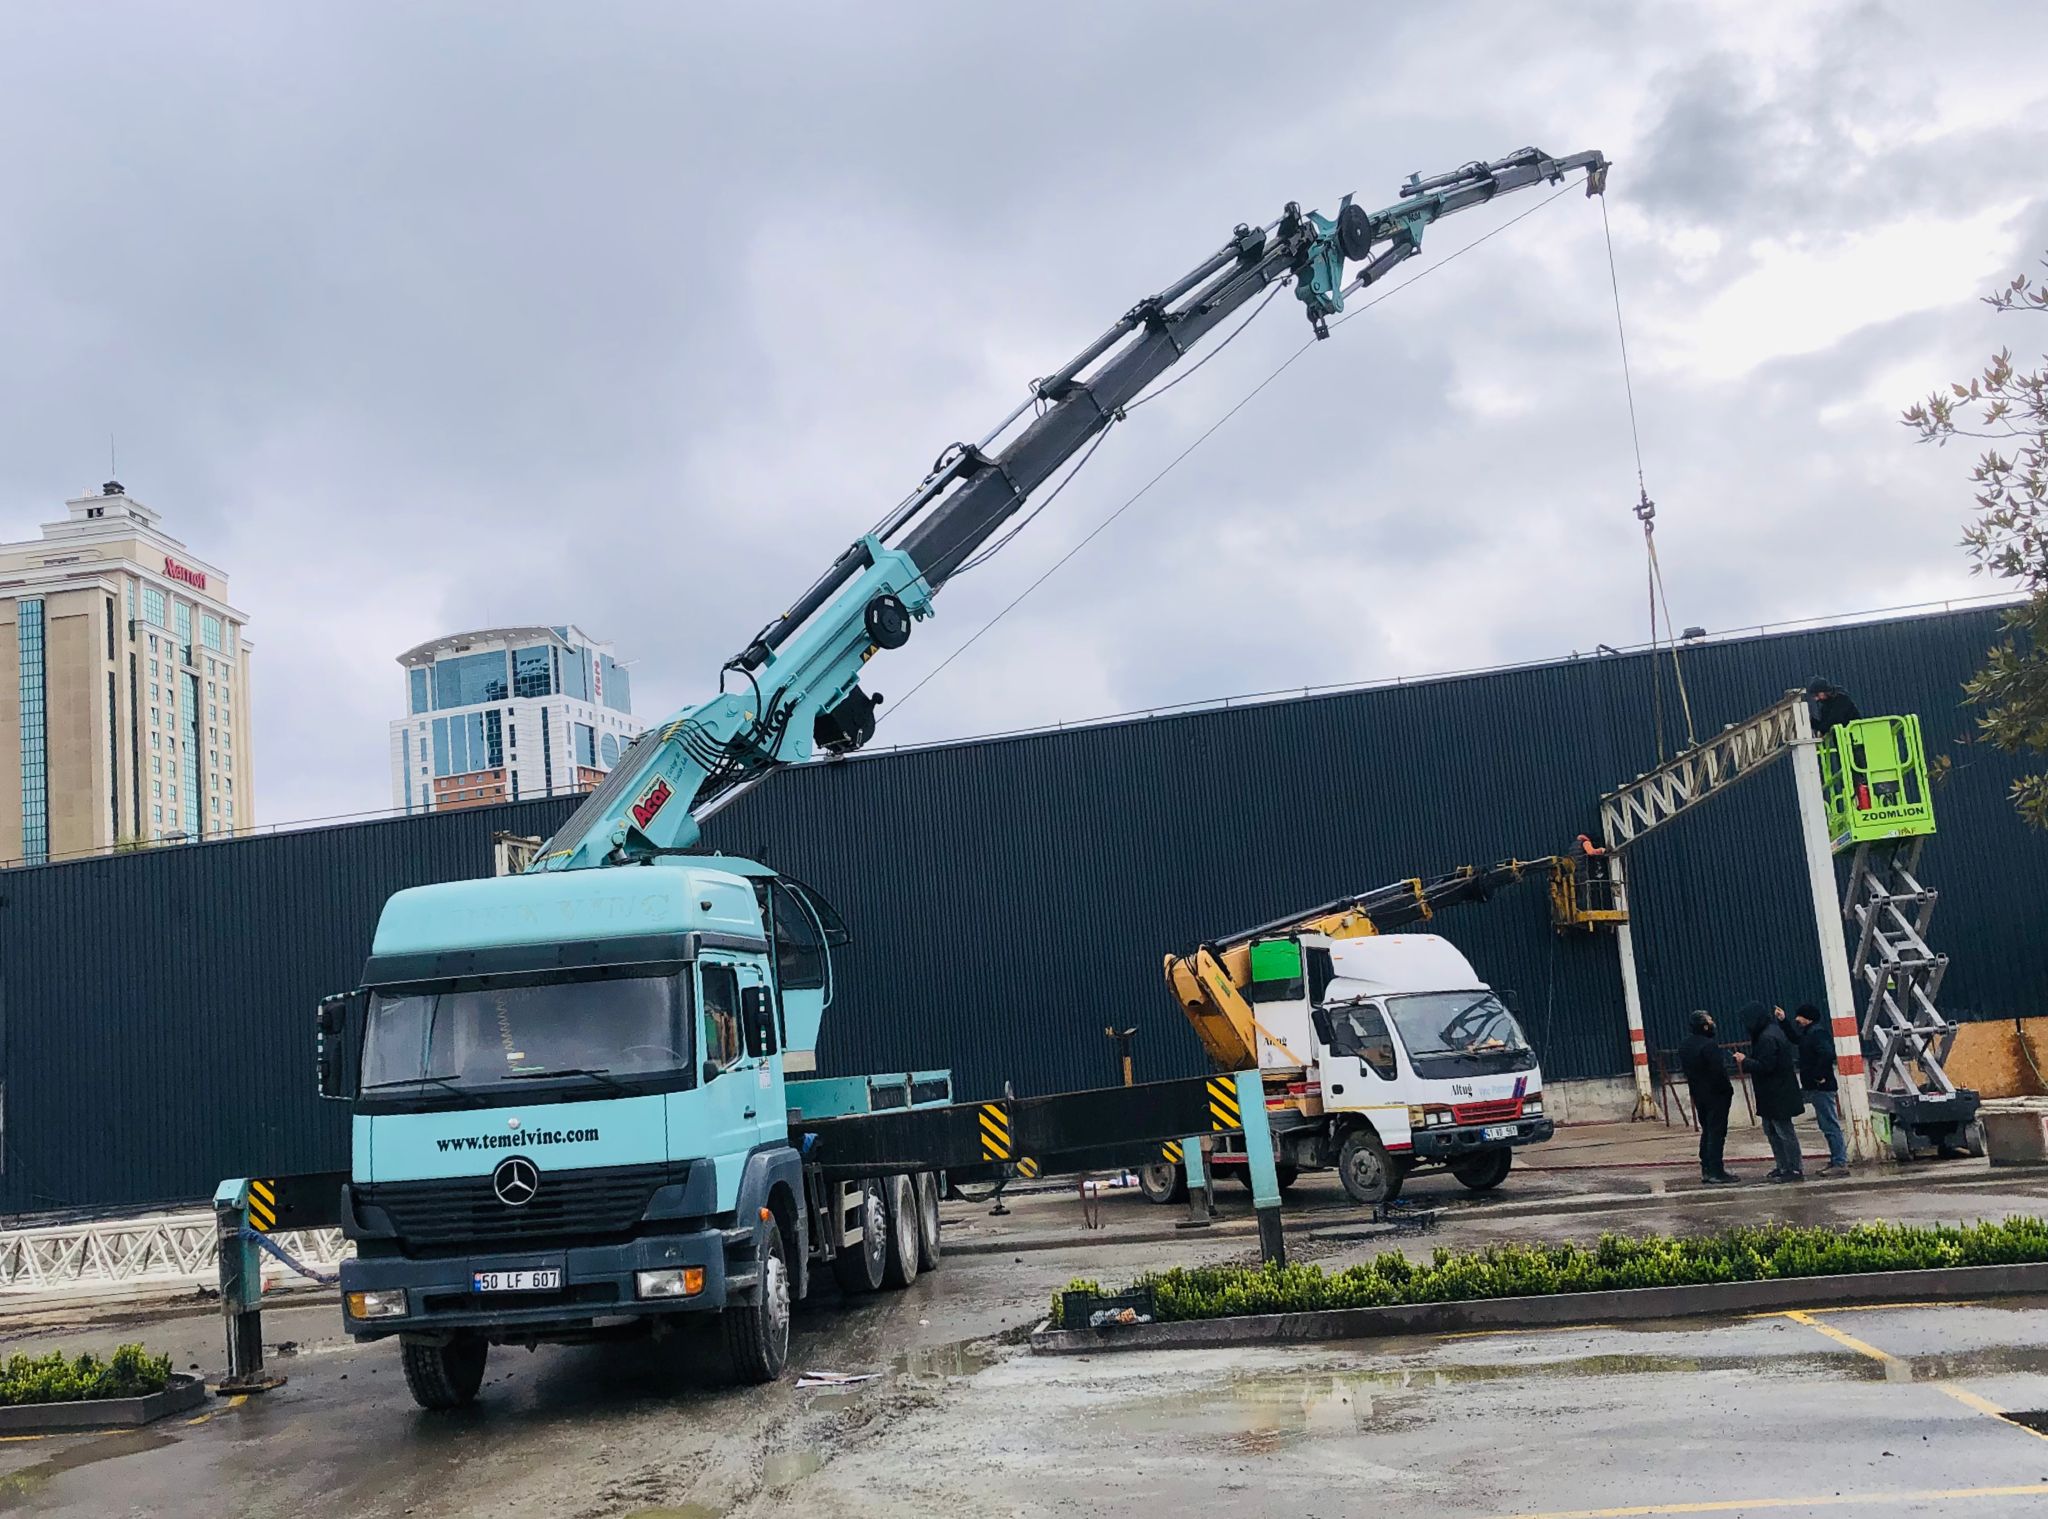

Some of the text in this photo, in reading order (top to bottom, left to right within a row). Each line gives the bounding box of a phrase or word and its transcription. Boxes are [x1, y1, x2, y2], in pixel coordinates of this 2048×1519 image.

[632, 780, 672, 830] Acar
[1862, 806, 1925, 821] ZOOMLION
[437, 1128, 599, 1152] www.temelvinc.com
[482, 1274, 498, 1289] 50
[507, 1273, 523, 1288] LF
[532, 1272, 557, 1288] 607
